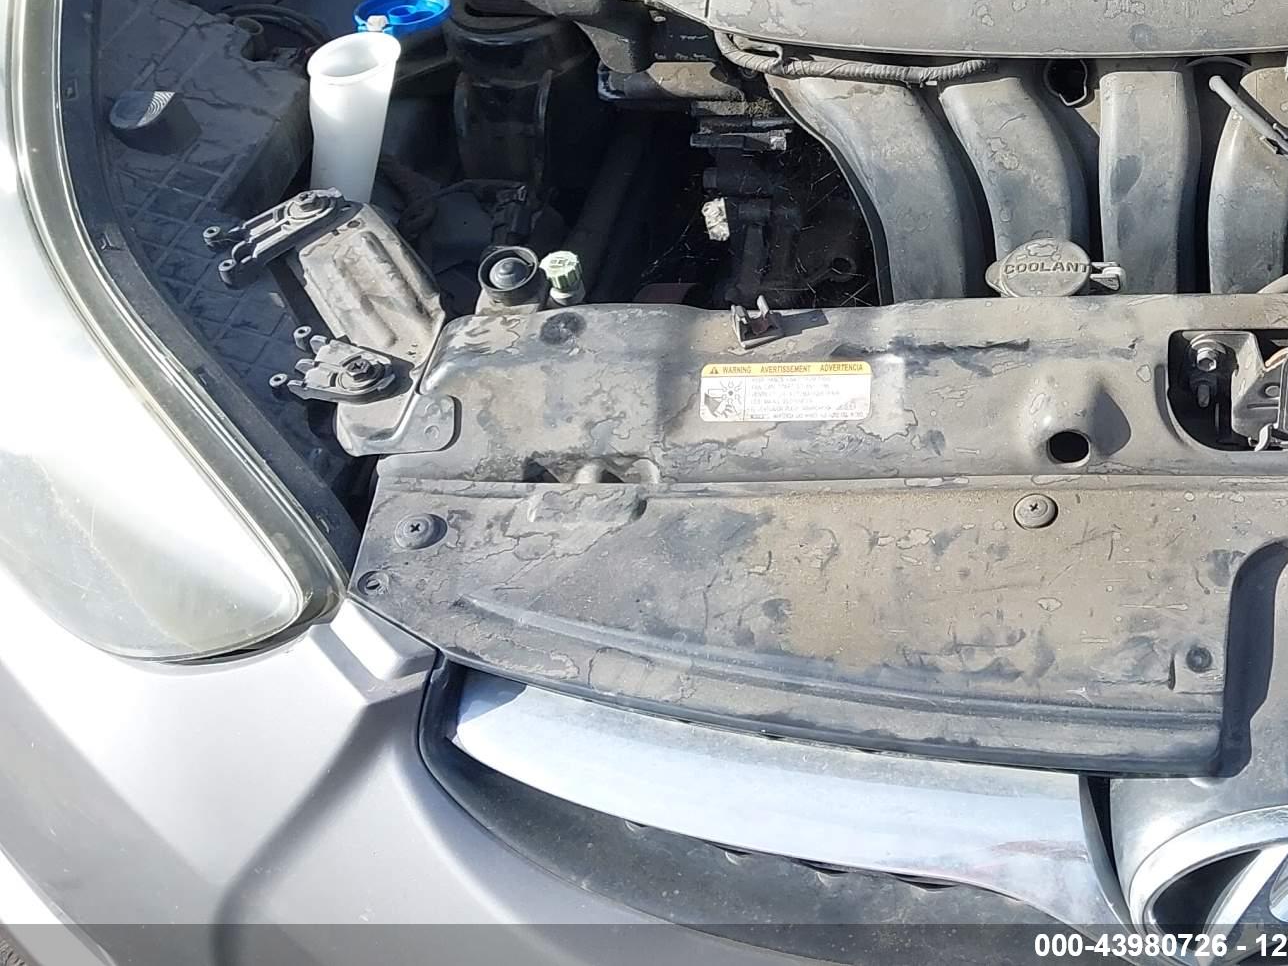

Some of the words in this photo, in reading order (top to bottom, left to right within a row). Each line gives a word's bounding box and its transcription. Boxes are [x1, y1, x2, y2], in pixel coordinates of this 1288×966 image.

[1004, 261, 1089, 275] COOLANT
[723, 366, 752, 374] WARNING
[760, 364, 812, 374] AVERTISSEMENT
[820, 363, 864, 372] ADVERTENCIA
